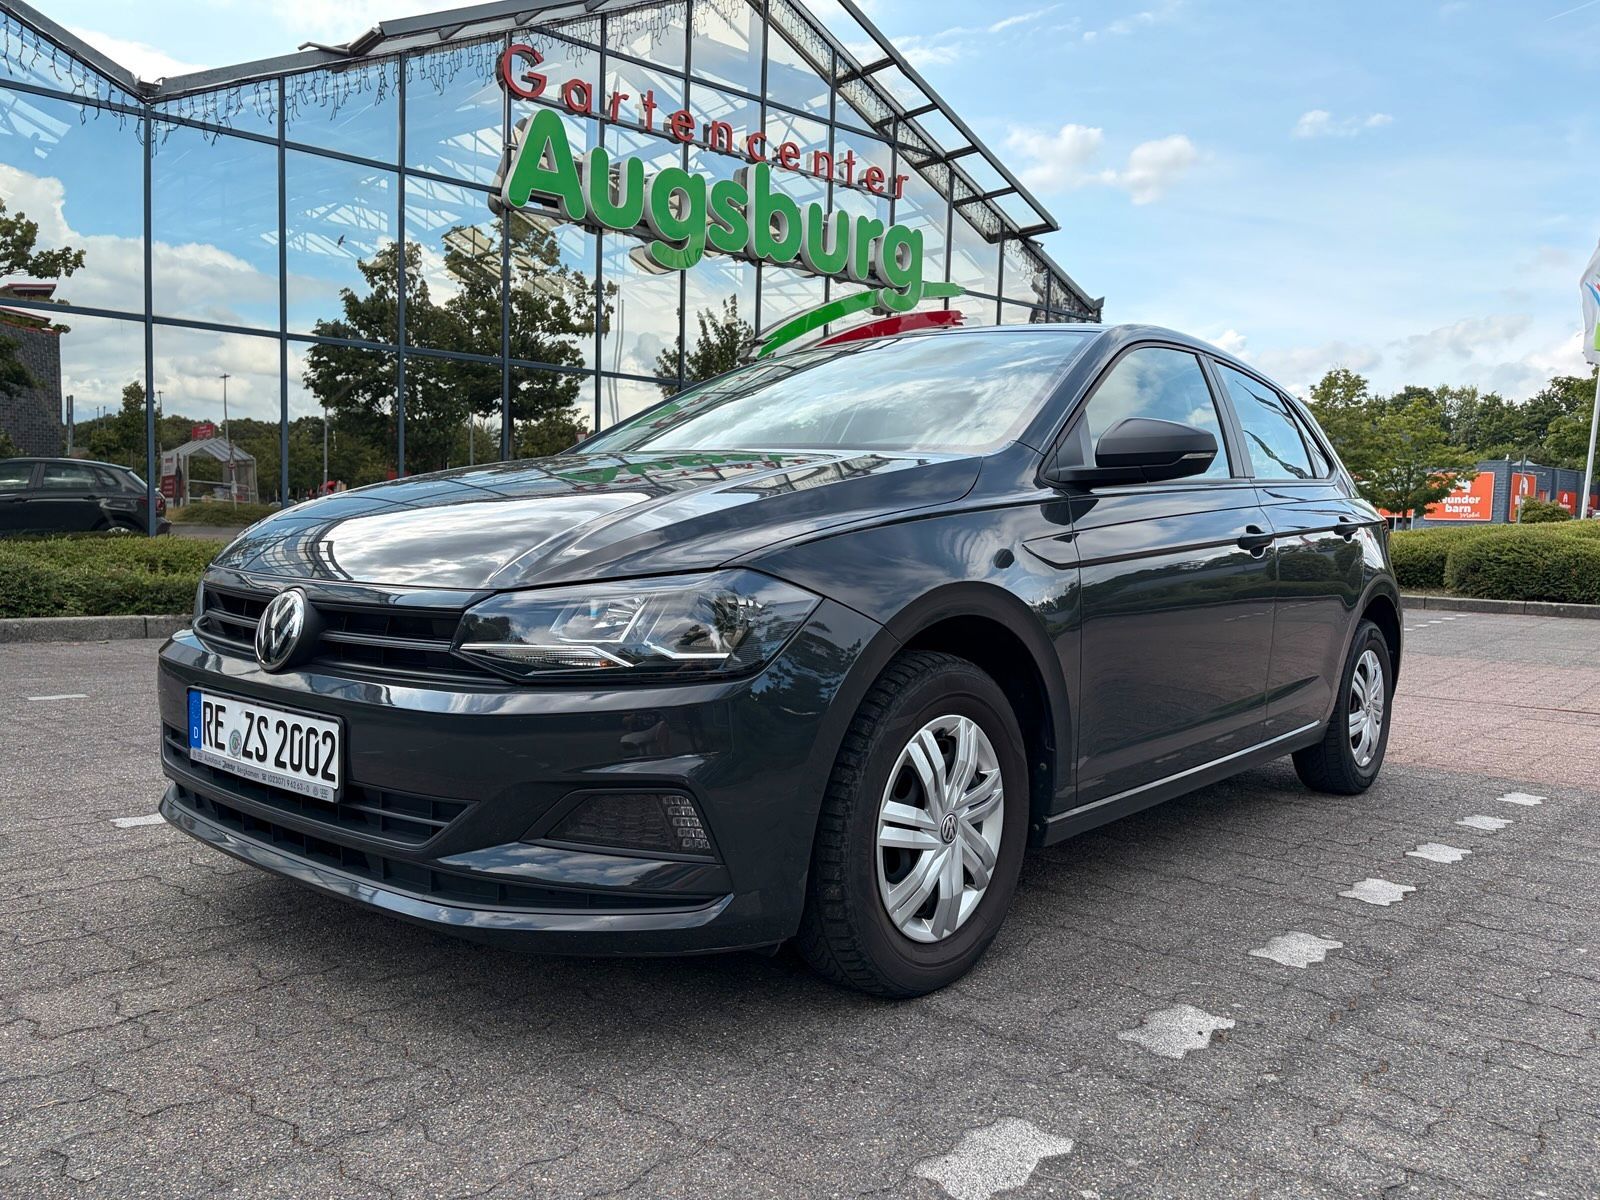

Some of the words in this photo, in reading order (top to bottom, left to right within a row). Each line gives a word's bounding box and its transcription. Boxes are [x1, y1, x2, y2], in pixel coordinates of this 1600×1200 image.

[500, 43, 910, 200] Gartencenter
[502, 108, 925, 313] Augsburg
[1445, 504, 1472, 513] barn
[193, 726, 199, 739] D
[202, 701, 227, 751] RE
[241, 711, 269, 763] ZS
[274, 719, 336, 782] 2002
